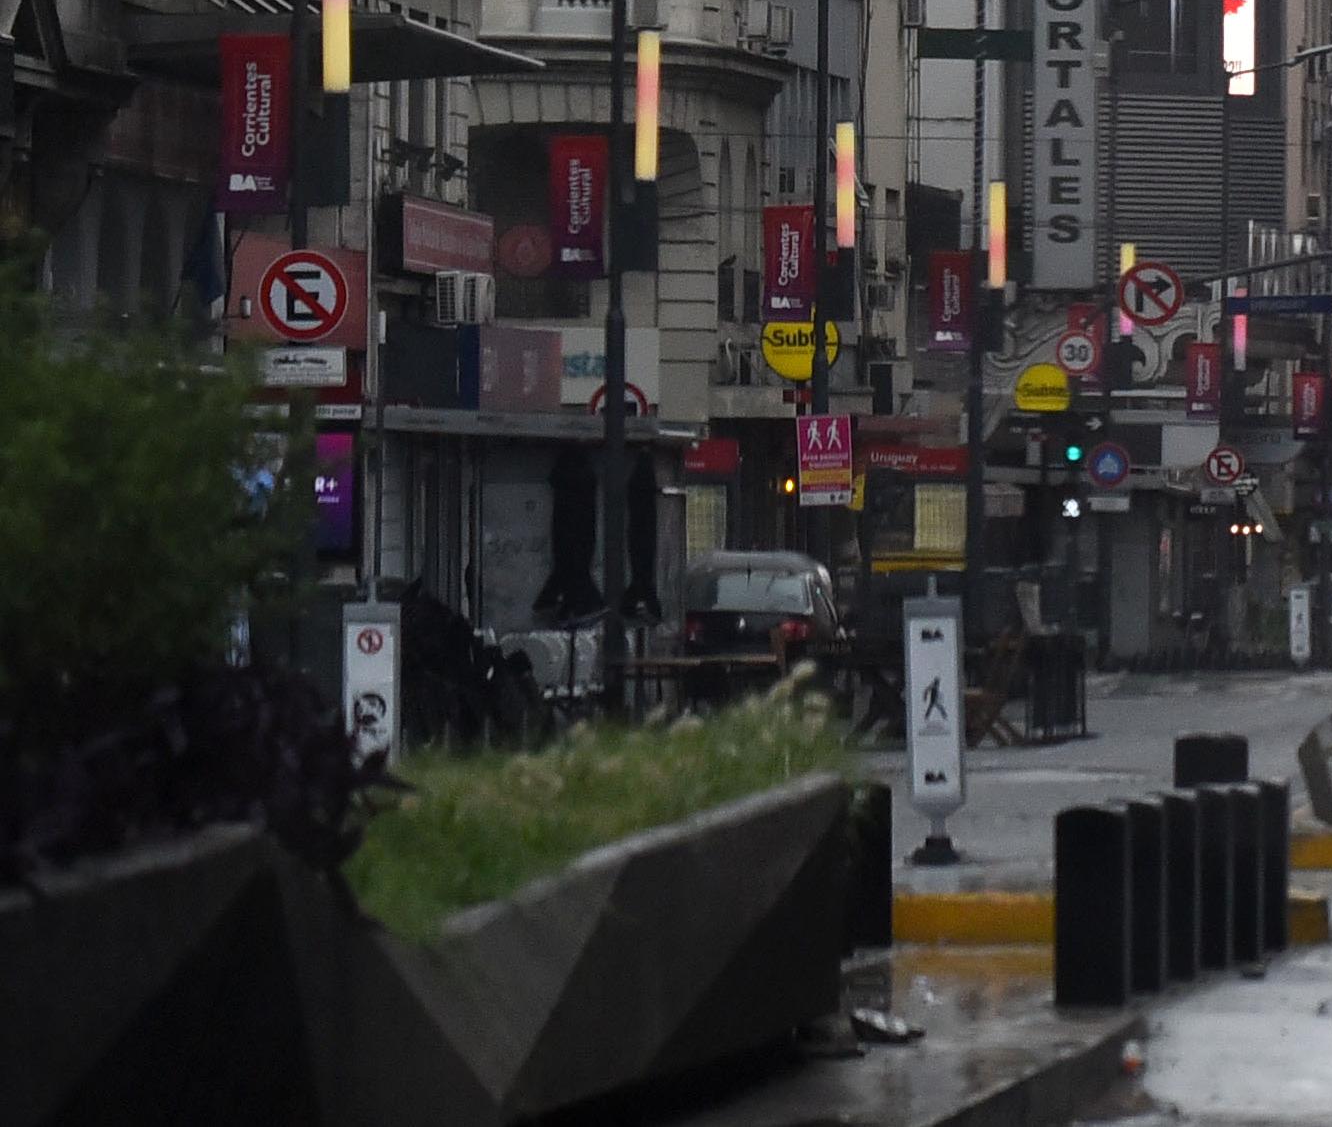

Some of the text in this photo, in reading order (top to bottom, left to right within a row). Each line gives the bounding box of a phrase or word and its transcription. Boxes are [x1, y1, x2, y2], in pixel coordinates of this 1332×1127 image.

[242, 62, 257, 157] Corrientes
[256, 74, 272, 146] Cultural
[579, 168, 592, 225] Cultural
[778, 223, 790, 286] Corrientes
[789, 230, 800, 278] Cultural
[870, 451, 918, 465] Uruguay
